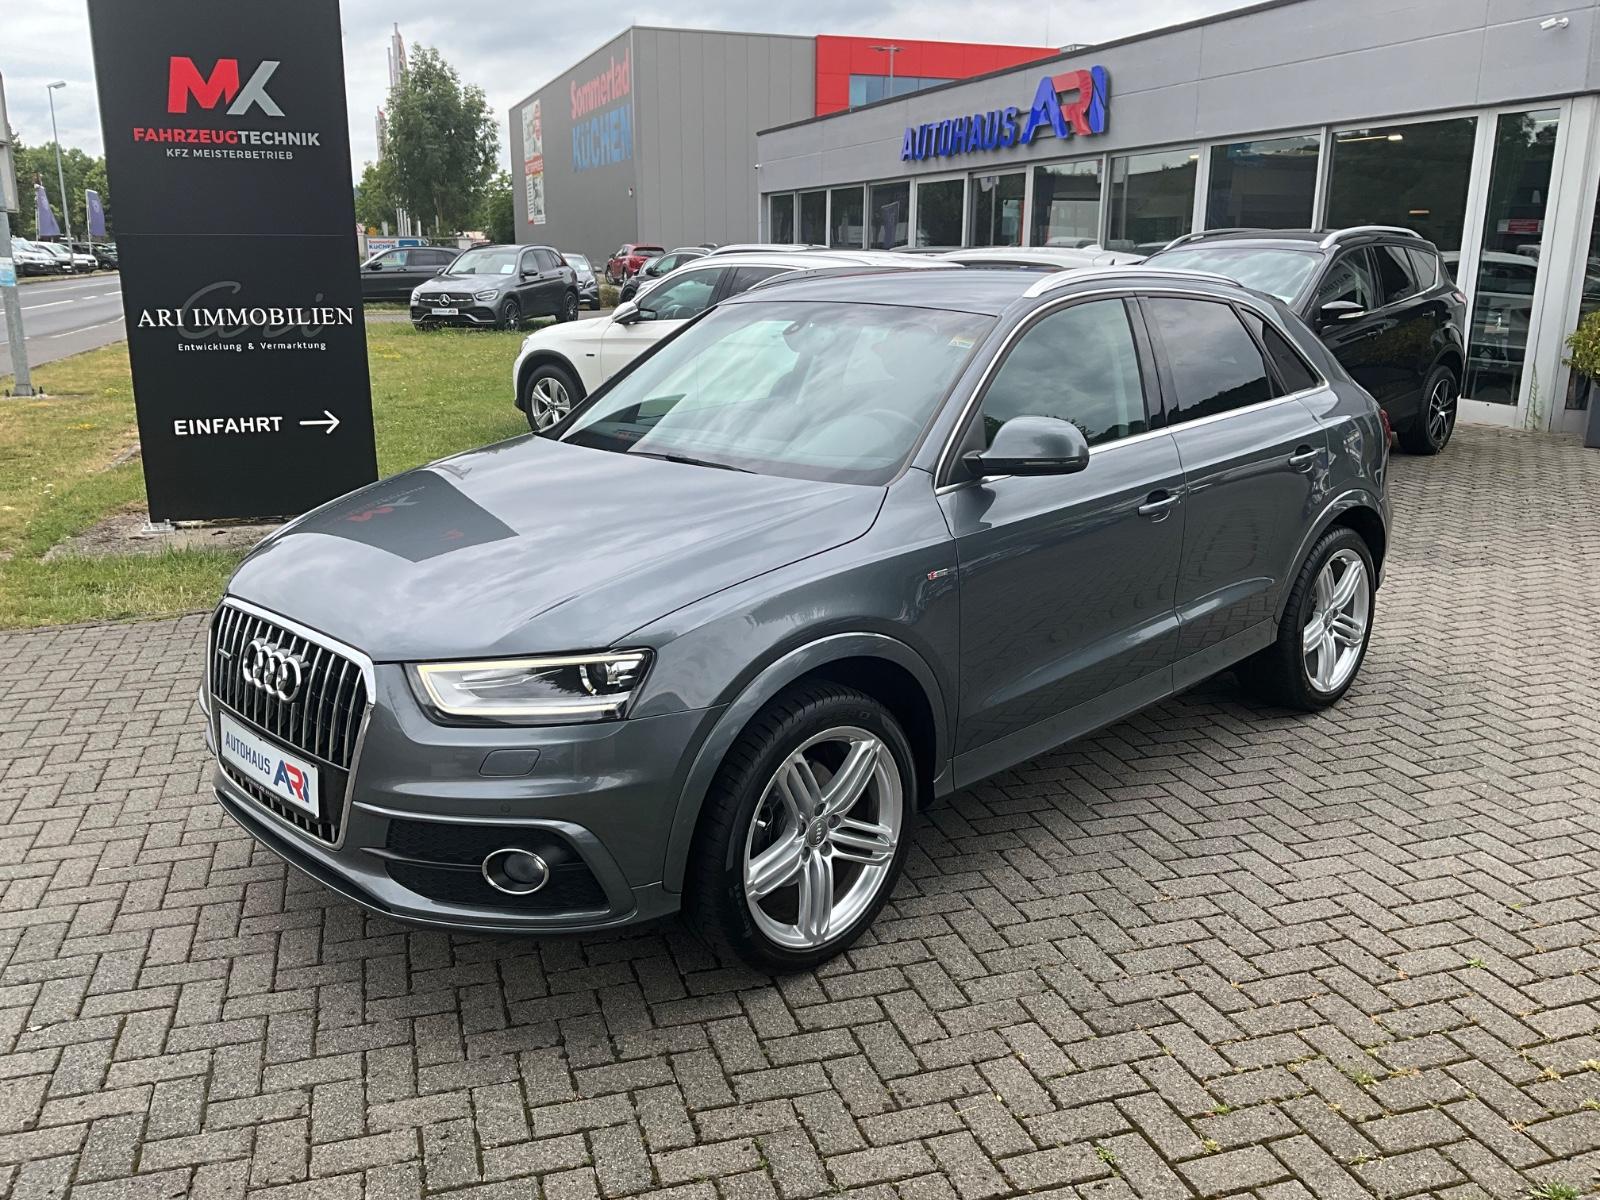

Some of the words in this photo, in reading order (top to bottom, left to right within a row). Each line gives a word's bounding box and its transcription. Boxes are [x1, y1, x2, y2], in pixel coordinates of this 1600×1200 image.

[167, 56, 286, 117] MK
[571, 47, 631, 120] Sommerlad
[901, 106, 1019, 161] AUTOHAUS
[1020, 65, 1111, 145] ARI
[133, 127, 321, 146] FAHRZEUGTECHNIK
[166, 148, 189, 158] KFZ
[193, 148, 294, 160] MEISTERBETRIEB
[137, 308, 185, 327] ARI
[192, 307, 354, 327] IMMOBILIEN
[178, 342, 243, 352] Entwicklung
[248, 341, 255, 350] &
[260, 341, 327, 351] Vermarktung
[173, 416, 283, 436] EINFAHRT
[225, 731, 271, 776] AUTOHAUS
[273, 759, 310, 804] ARI
